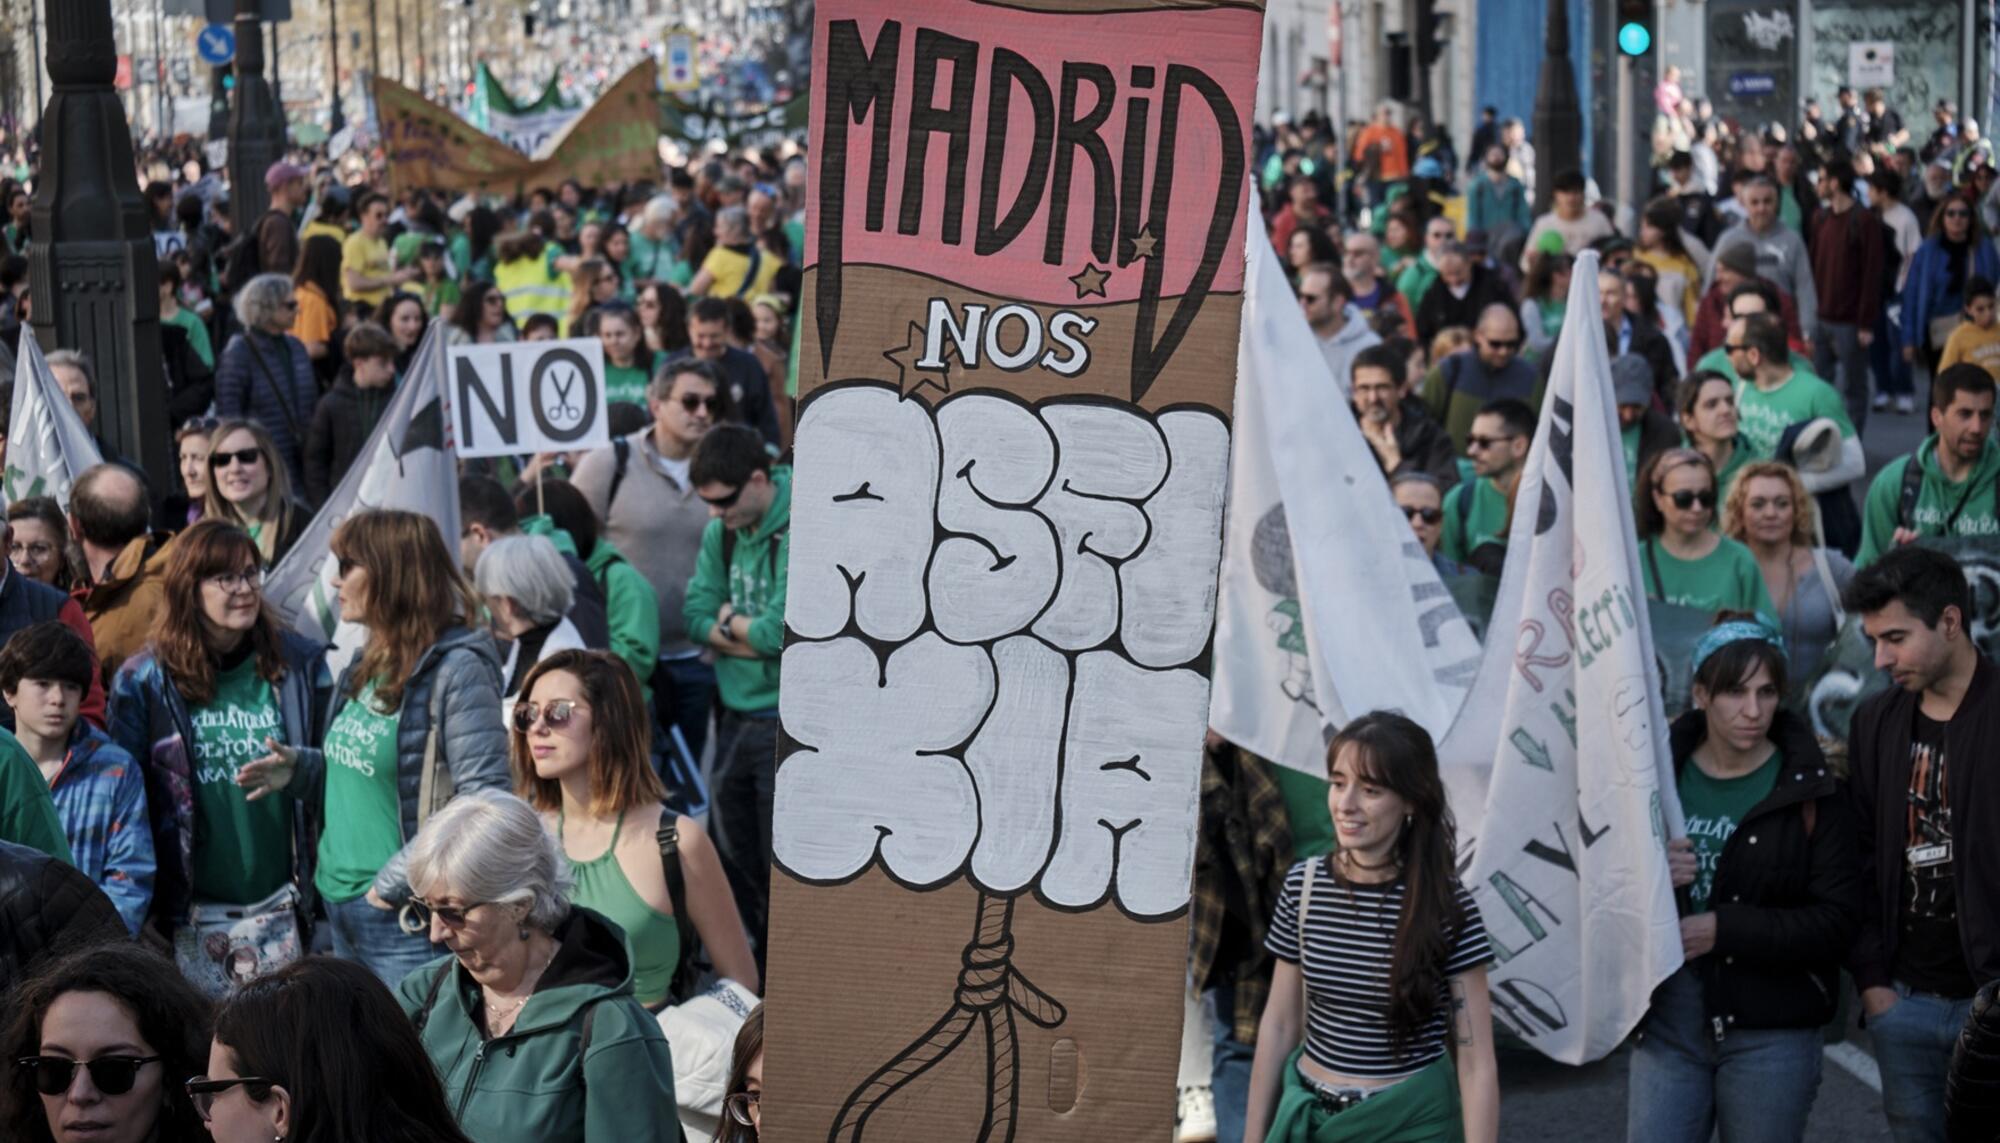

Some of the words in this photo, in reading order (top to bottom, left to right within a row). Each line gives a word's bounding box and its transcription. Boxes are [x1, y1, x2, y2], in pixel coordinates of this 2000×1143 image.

[915, 297, 1098, 378] NOS
[455, 347, 598, 448] NO
[770, 632, 1210, 923] XIA
